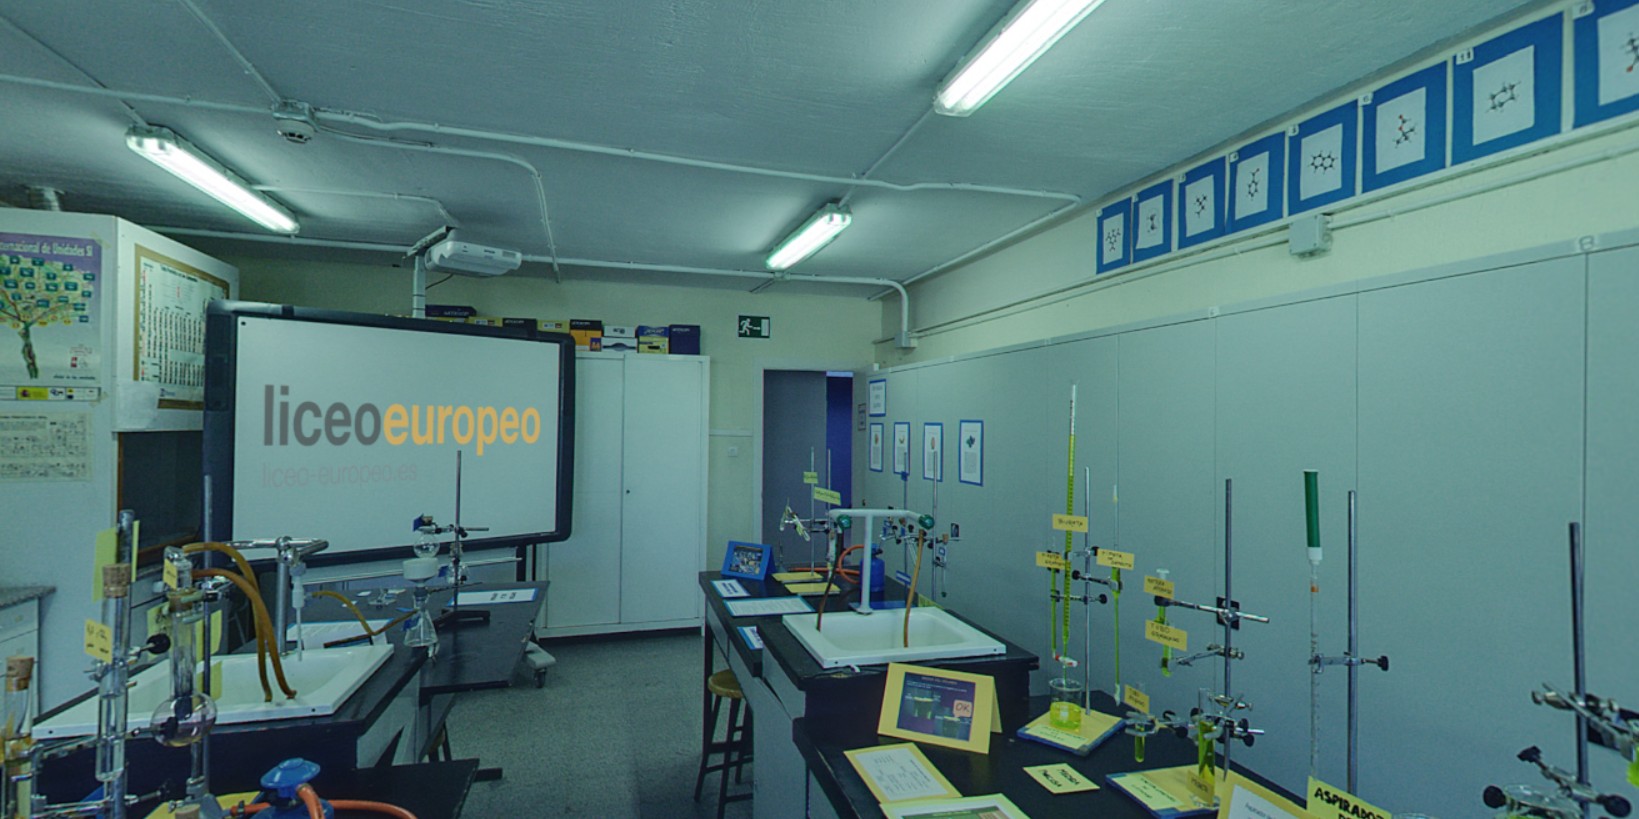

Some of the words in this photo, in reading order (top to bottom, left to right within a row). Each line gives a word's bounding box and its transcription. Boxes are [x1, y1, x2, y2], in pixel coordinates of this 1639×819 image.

[41, 242, 51, 254] de
[52, 242, 86, 257] Unidades
[264, 384, 541, 456] liceoeuropeo
[262, 461, 418, 489] liceo-europeo.es
[955, 701, 970, 713] OK
